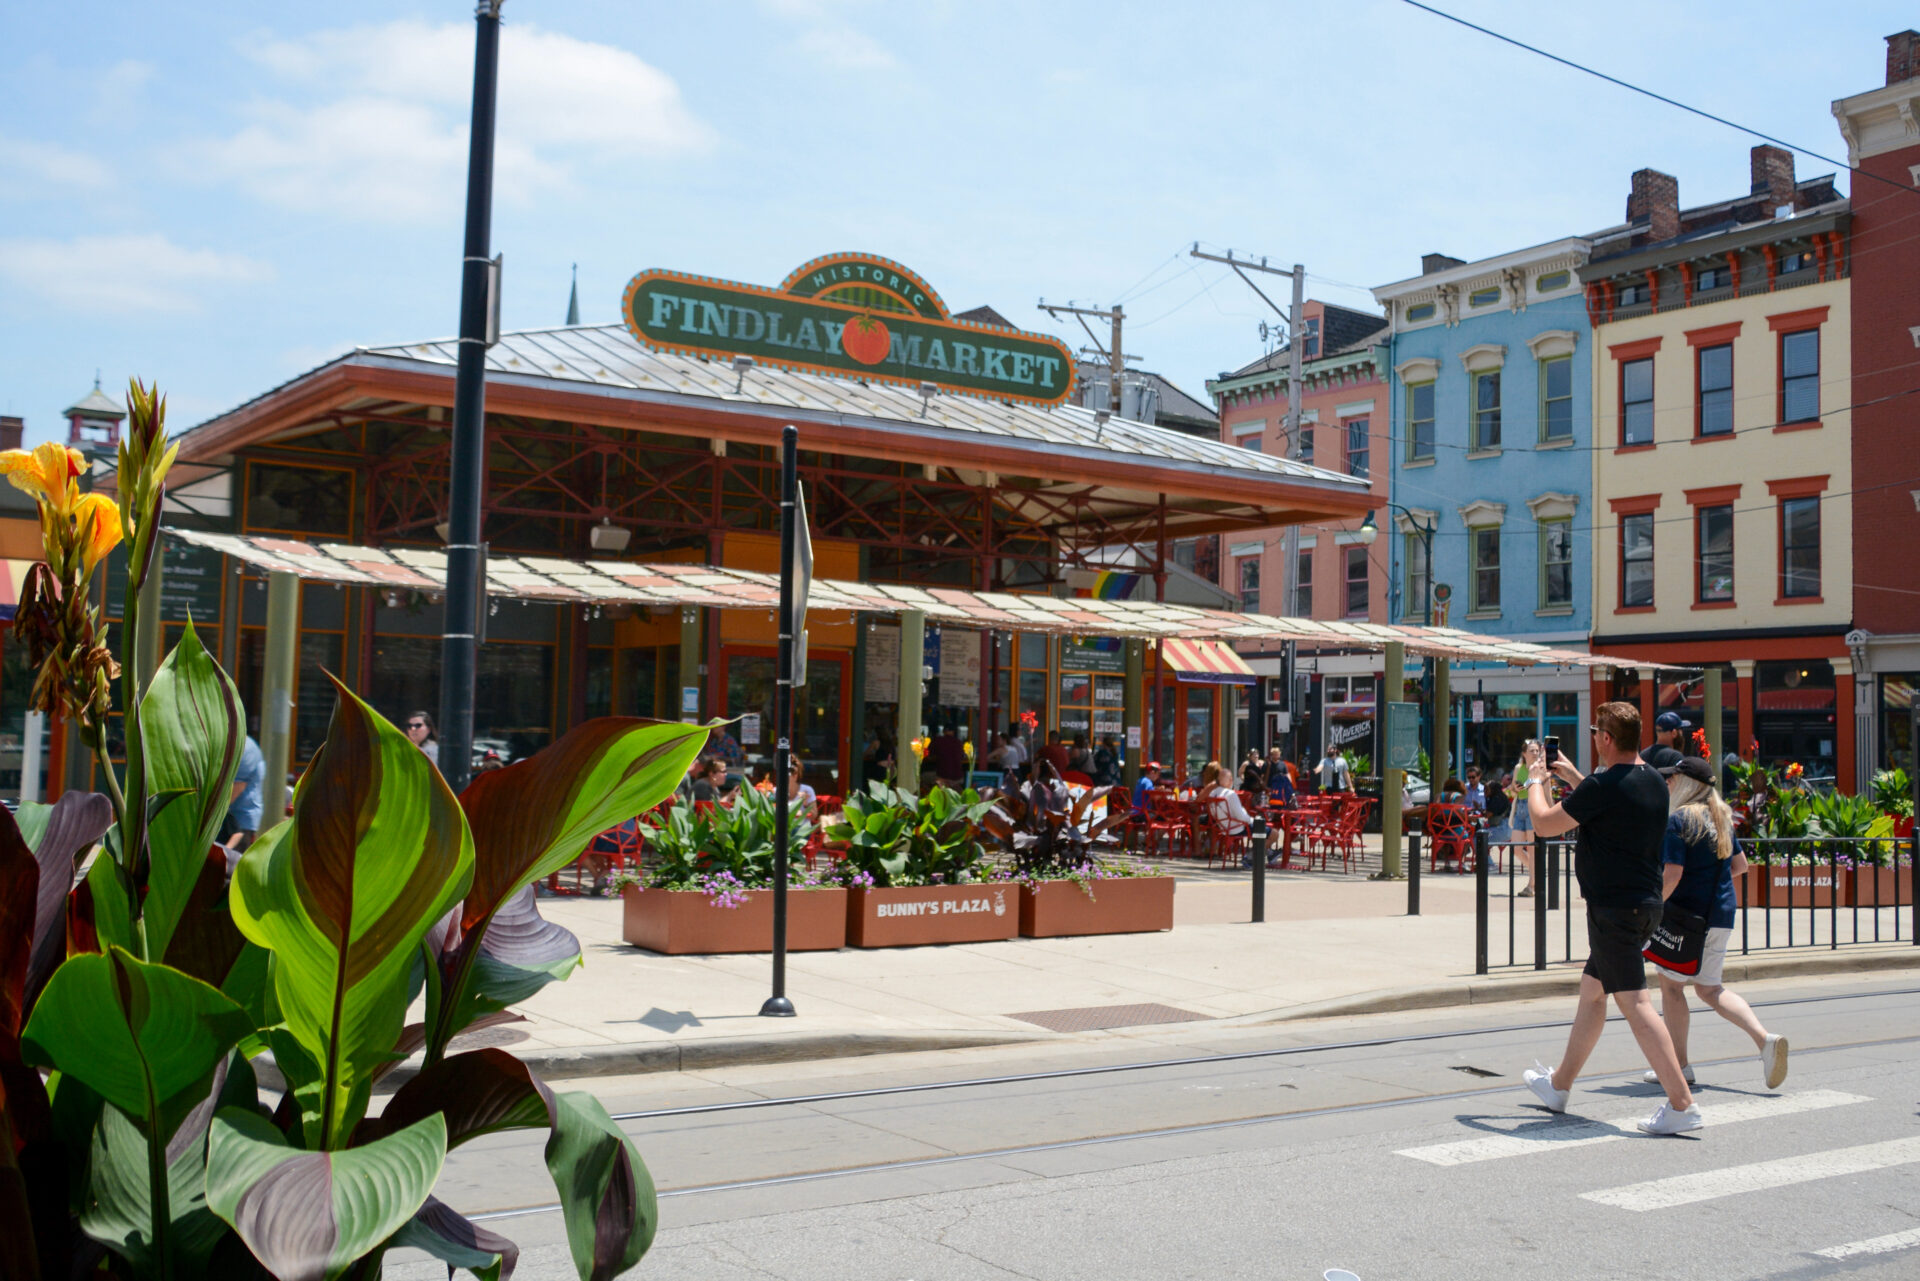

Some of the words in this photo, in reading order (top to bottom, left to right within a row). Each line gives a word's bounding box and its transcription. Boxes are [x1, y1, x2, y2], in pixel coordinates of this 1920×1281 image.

[813, 266, 924, 306] HISTORIC
[648, 292, 846, 355] FINDLAY
[886, 331, 1060, 388] MARKET
[1330, 720, 1371, 746] MAVERICK
[877, 901, 939, 917] BUNNY'S
[943, 898, 991, 914] PLAZA
